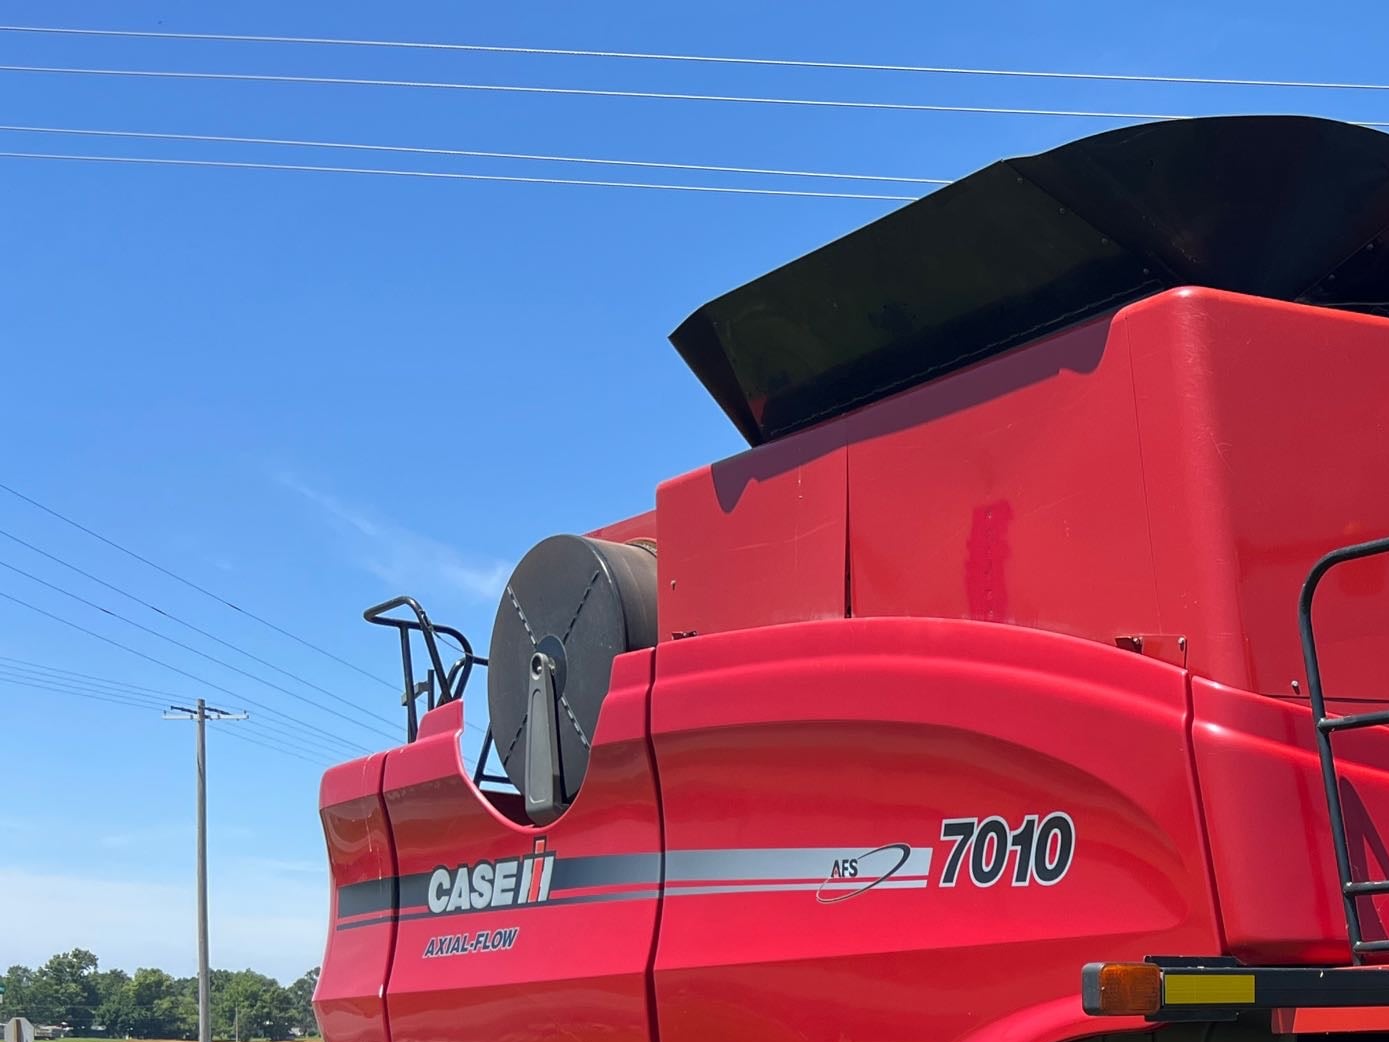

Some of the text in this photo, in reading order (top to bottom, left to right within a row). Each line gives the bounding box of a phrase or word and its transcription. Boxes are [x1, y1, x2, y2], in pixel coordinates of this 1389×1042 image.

[830, 858, 858, 878] AFS
[939, 811, 1075, 888] 7010
[428, 860, 519, 914] CASE
